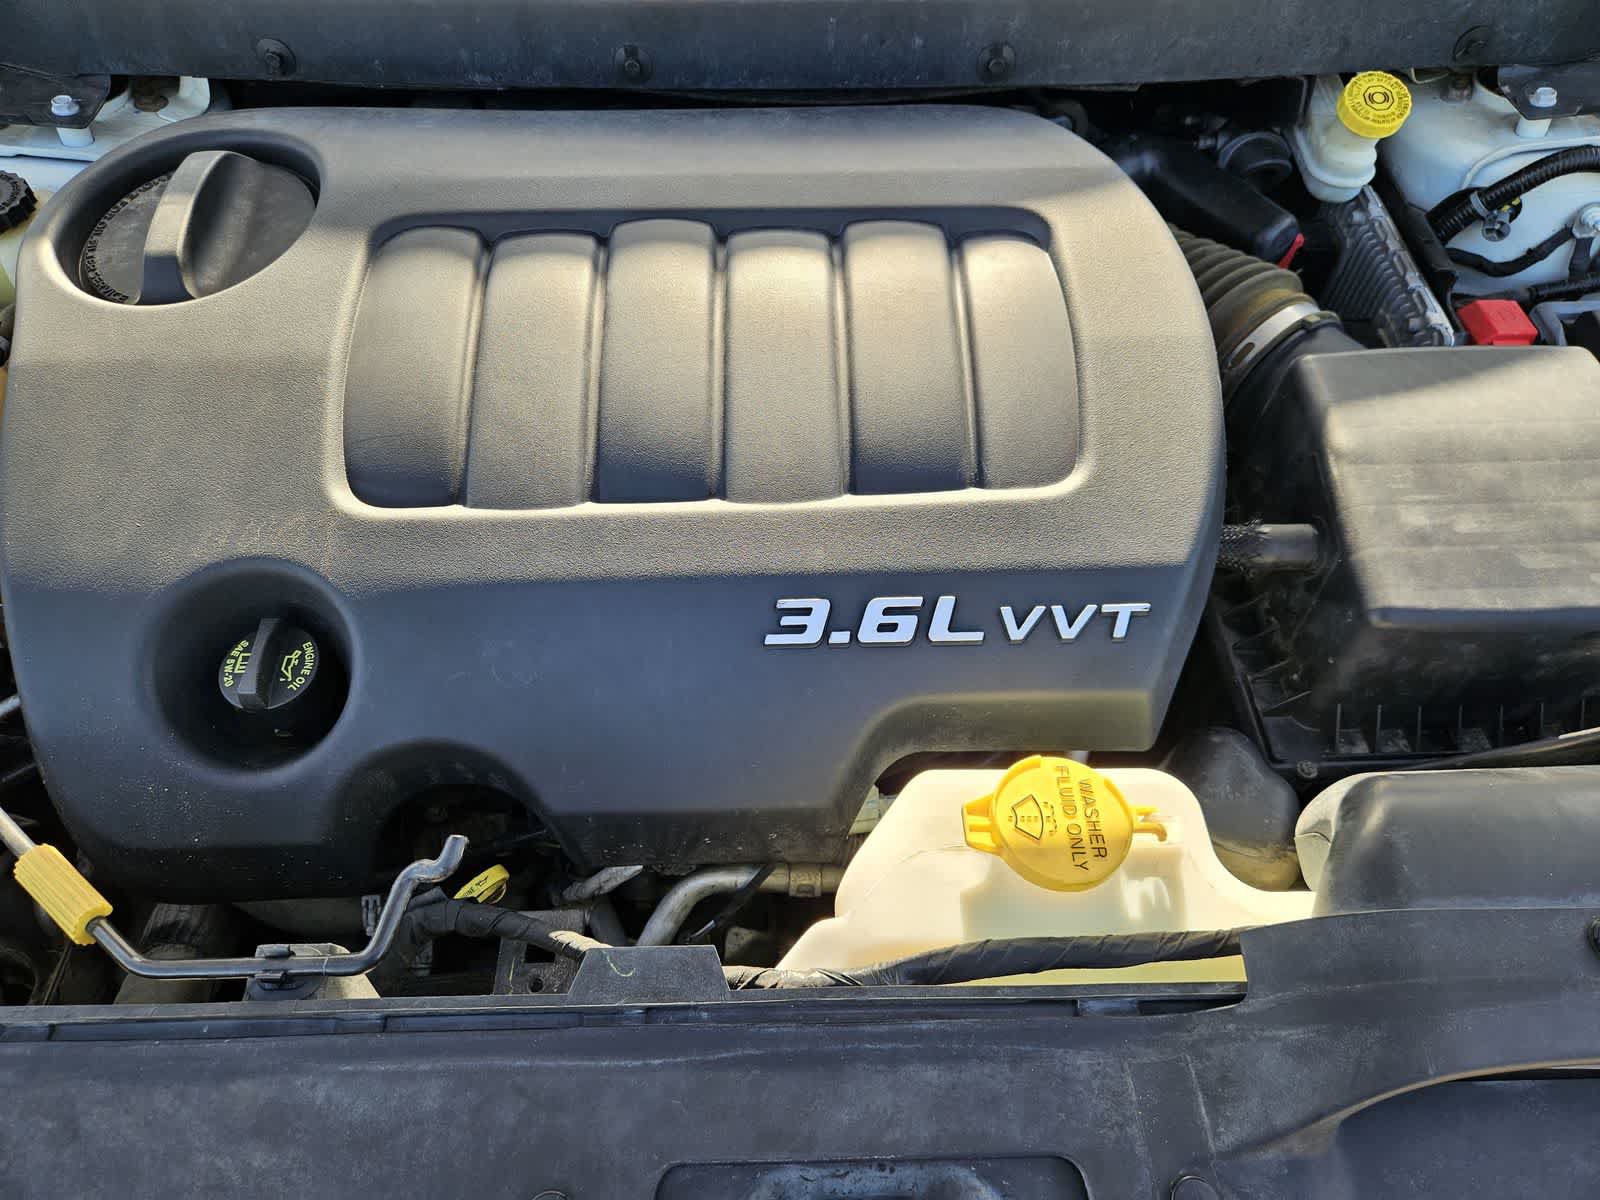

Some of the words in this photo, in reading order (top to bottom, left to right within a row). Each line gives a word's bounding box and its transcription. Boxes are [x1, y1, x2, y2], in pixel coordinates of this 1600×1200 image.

[764, 595, 985, 647] 3.6L
[1000, 603, 1152, 644] VVT
[230, 640, 249, 657] SAE
[302, 641, 315, 676] ENGINE
[223, 659, 235, 688] 5W-20
[287, 676, 306, 691] OIL
[1055, 765, 1078, 819] FLUID
[1079, 778, 1108, 858] WASHER
[1066, 823, 1089, 871] ONLY
